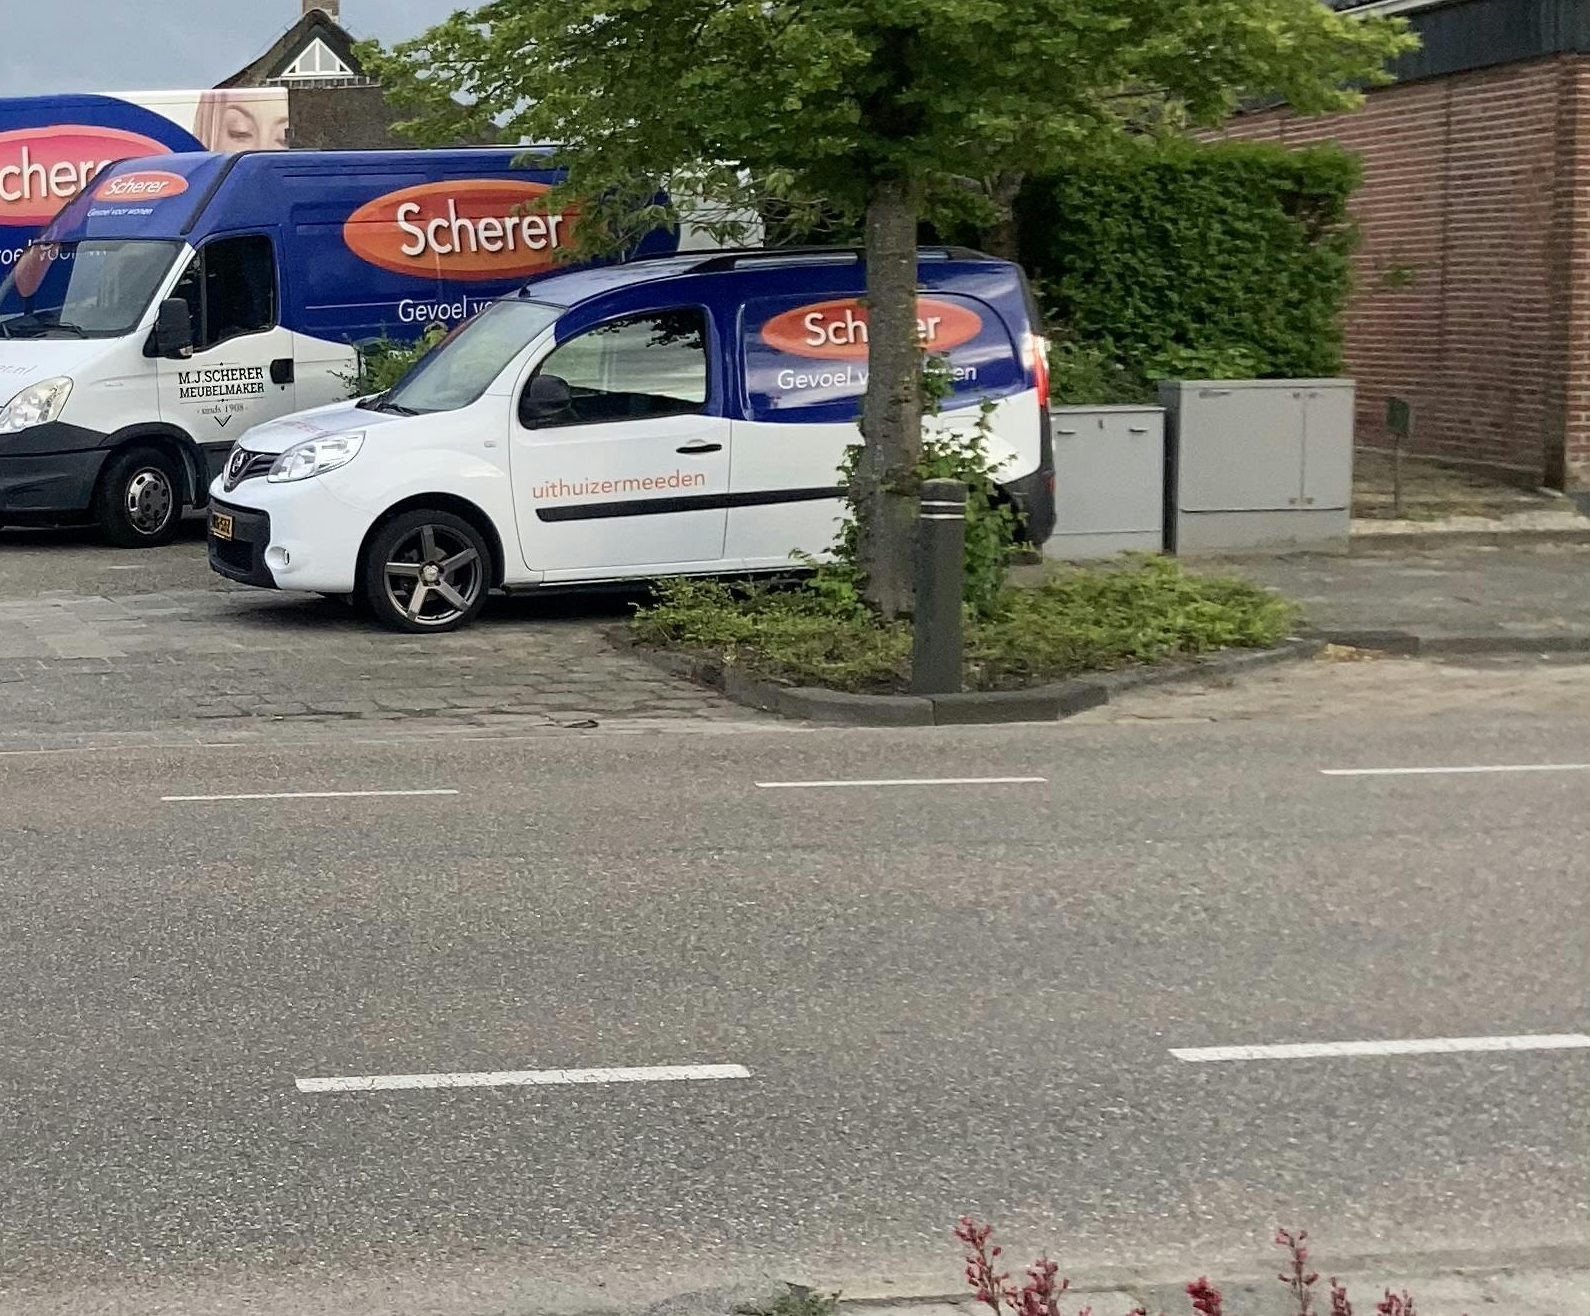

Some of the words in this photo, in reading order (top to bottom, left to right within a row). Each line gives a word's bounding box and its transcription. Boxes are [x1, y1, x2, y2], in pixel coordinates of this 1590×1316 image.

[105, 177, 169, 195] Scherer
[397, 198, 563, 257] Scherer
[398, 294, 467, 322] Gevoel
[804, 309, 941, 347] Scher
[179, 382, 265, 399] MEUBELMAKER
[778, 366, 851, 390] Gevoel
[532, 469, 705, 499] uithuizermeeden
